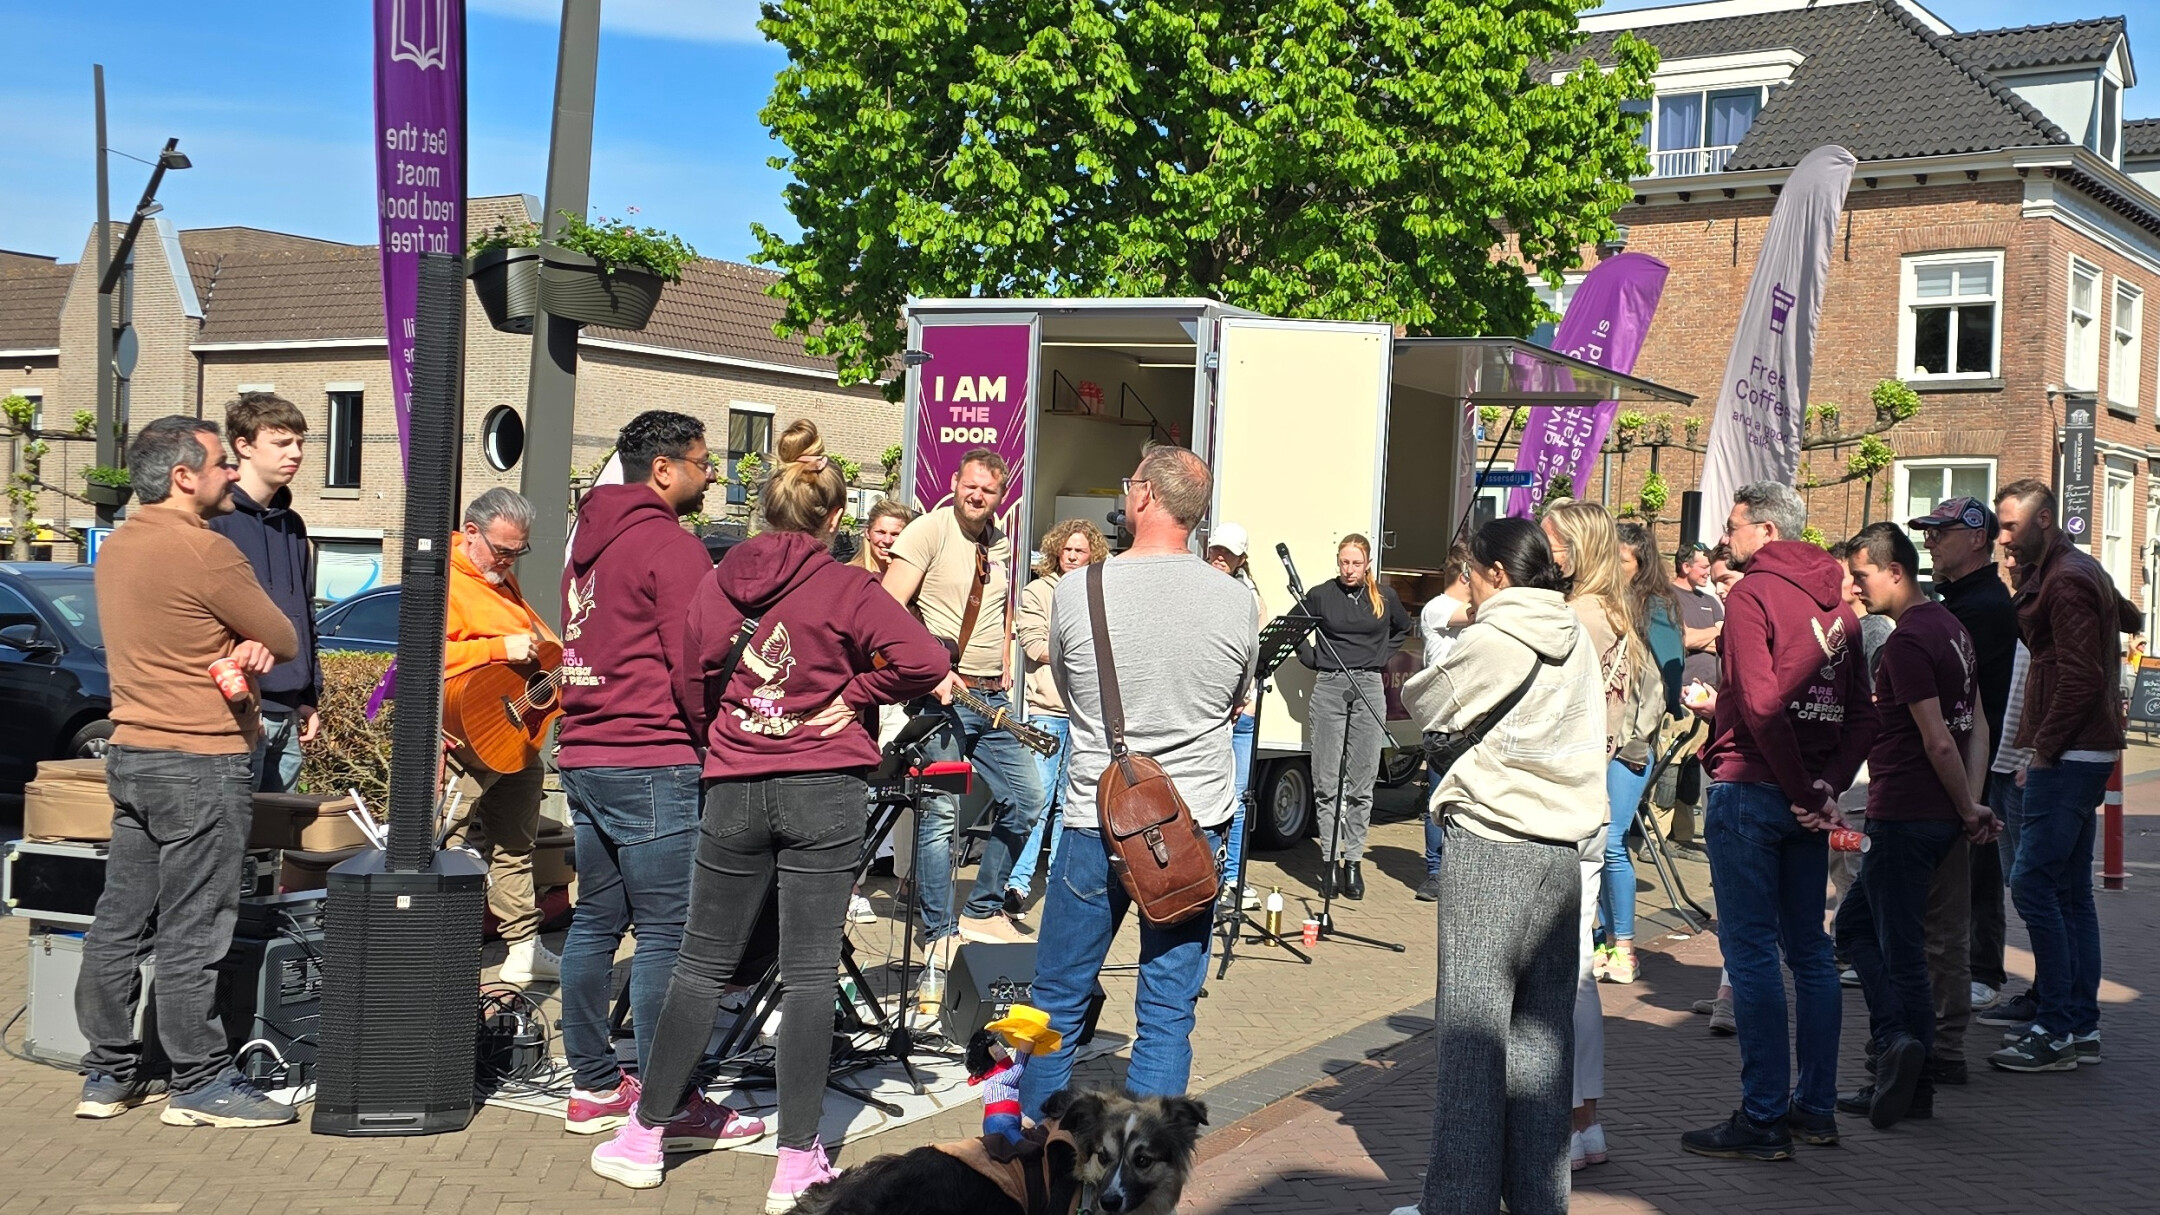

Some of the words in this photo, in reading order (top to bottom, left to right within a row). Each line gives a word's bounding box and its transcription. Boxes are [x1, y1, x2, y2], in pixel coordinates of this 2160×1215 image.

[1591, 319, 1610, 339] is
[1750, 356, 1787, 391] Free
[935, 376, 944, 402] I
[952, 375, 1007, 402] AM
[1735, 378, 1791, 421] Coffee
[949, 406, 990, 423] THE
[940, 427, 998, 444] DOOR
[1732, 410, 1752, 426] and
[1754, 421, 1762, 430] a
[1764, 425, 1789, 444] good
[1481, 475, 1526, 484] issersdijk
[1527, 448, 1549, 514] never
[562, 648, 576, 658] RE
[1808, 685, 1834, 696] ARE
[1790, 700, 1801, 710] A
[1815, 694, 1838, 705] YOU
[1797, 710, 1819, 720] OF
